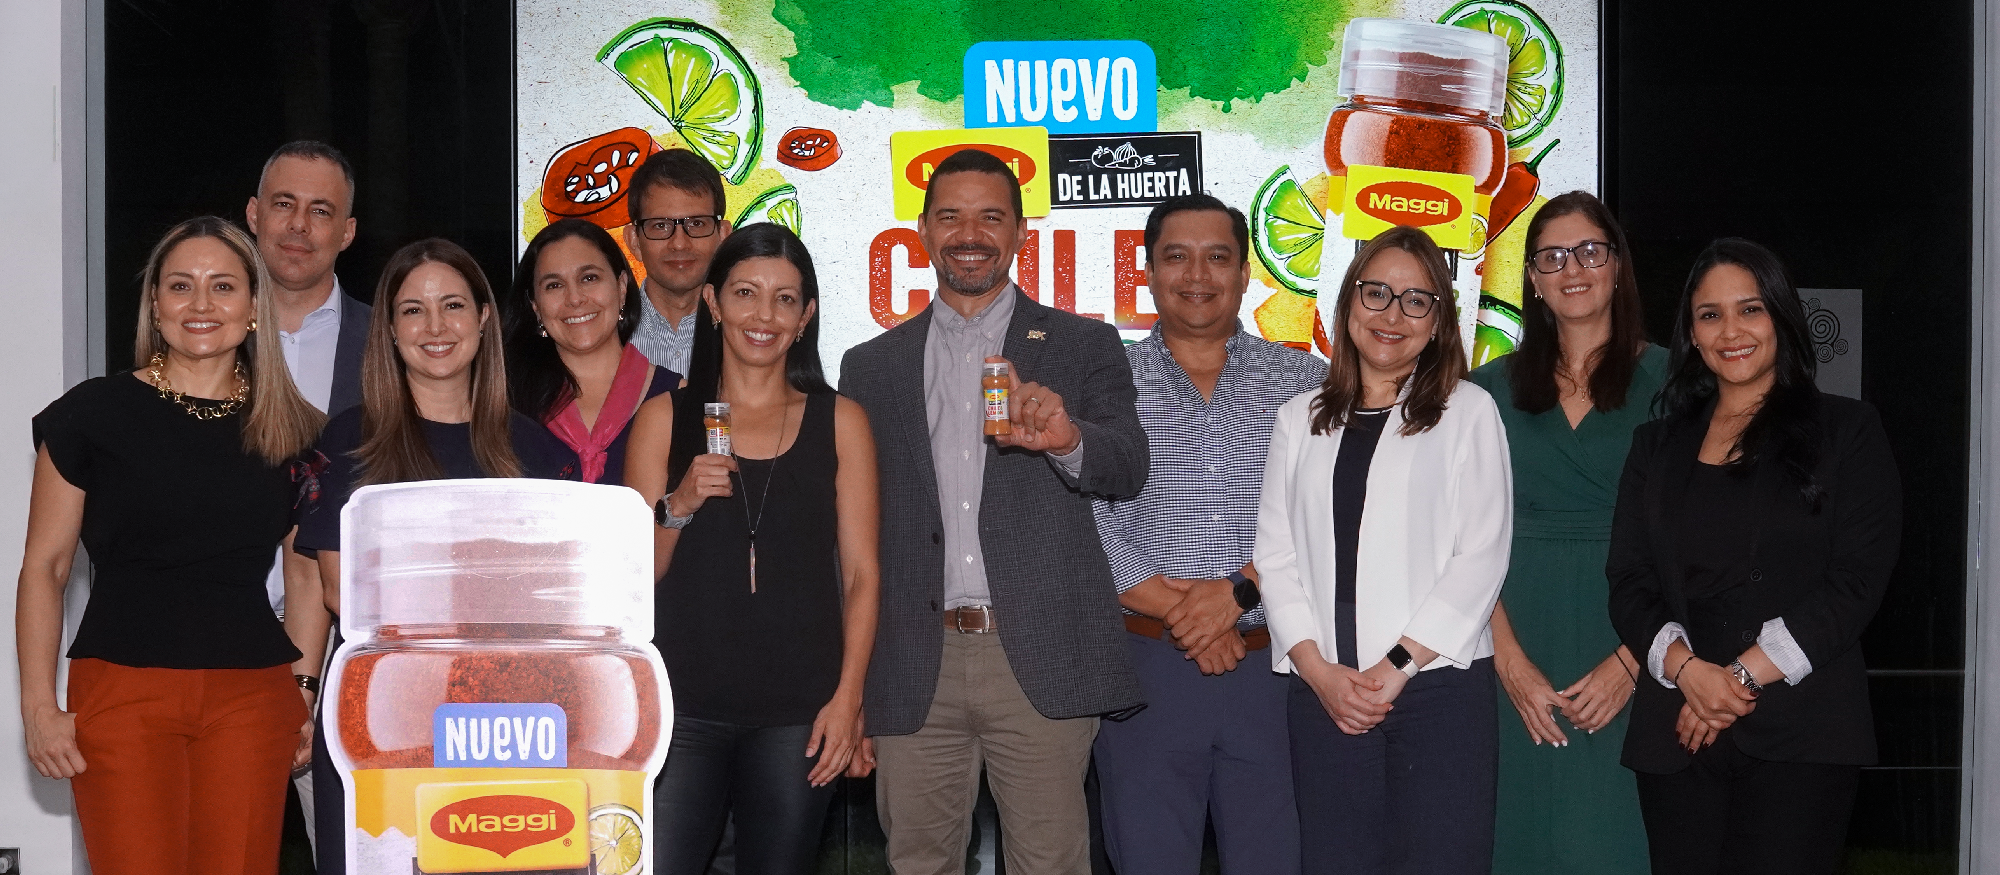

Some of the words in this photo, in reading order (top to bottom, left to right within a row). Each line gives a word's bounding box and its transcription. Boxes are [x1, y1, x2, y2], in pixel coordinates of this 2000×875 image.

[1057, 173, 1082, 202] DE
[1088, 173, 1111, 200] LA
[1117, 168, 1192, 198] HUERTA
[1369, 192, 1449, 216] Maggi
[869, 228, 1160, 330] CILE
[449, 809, 557, 834] Maggi
